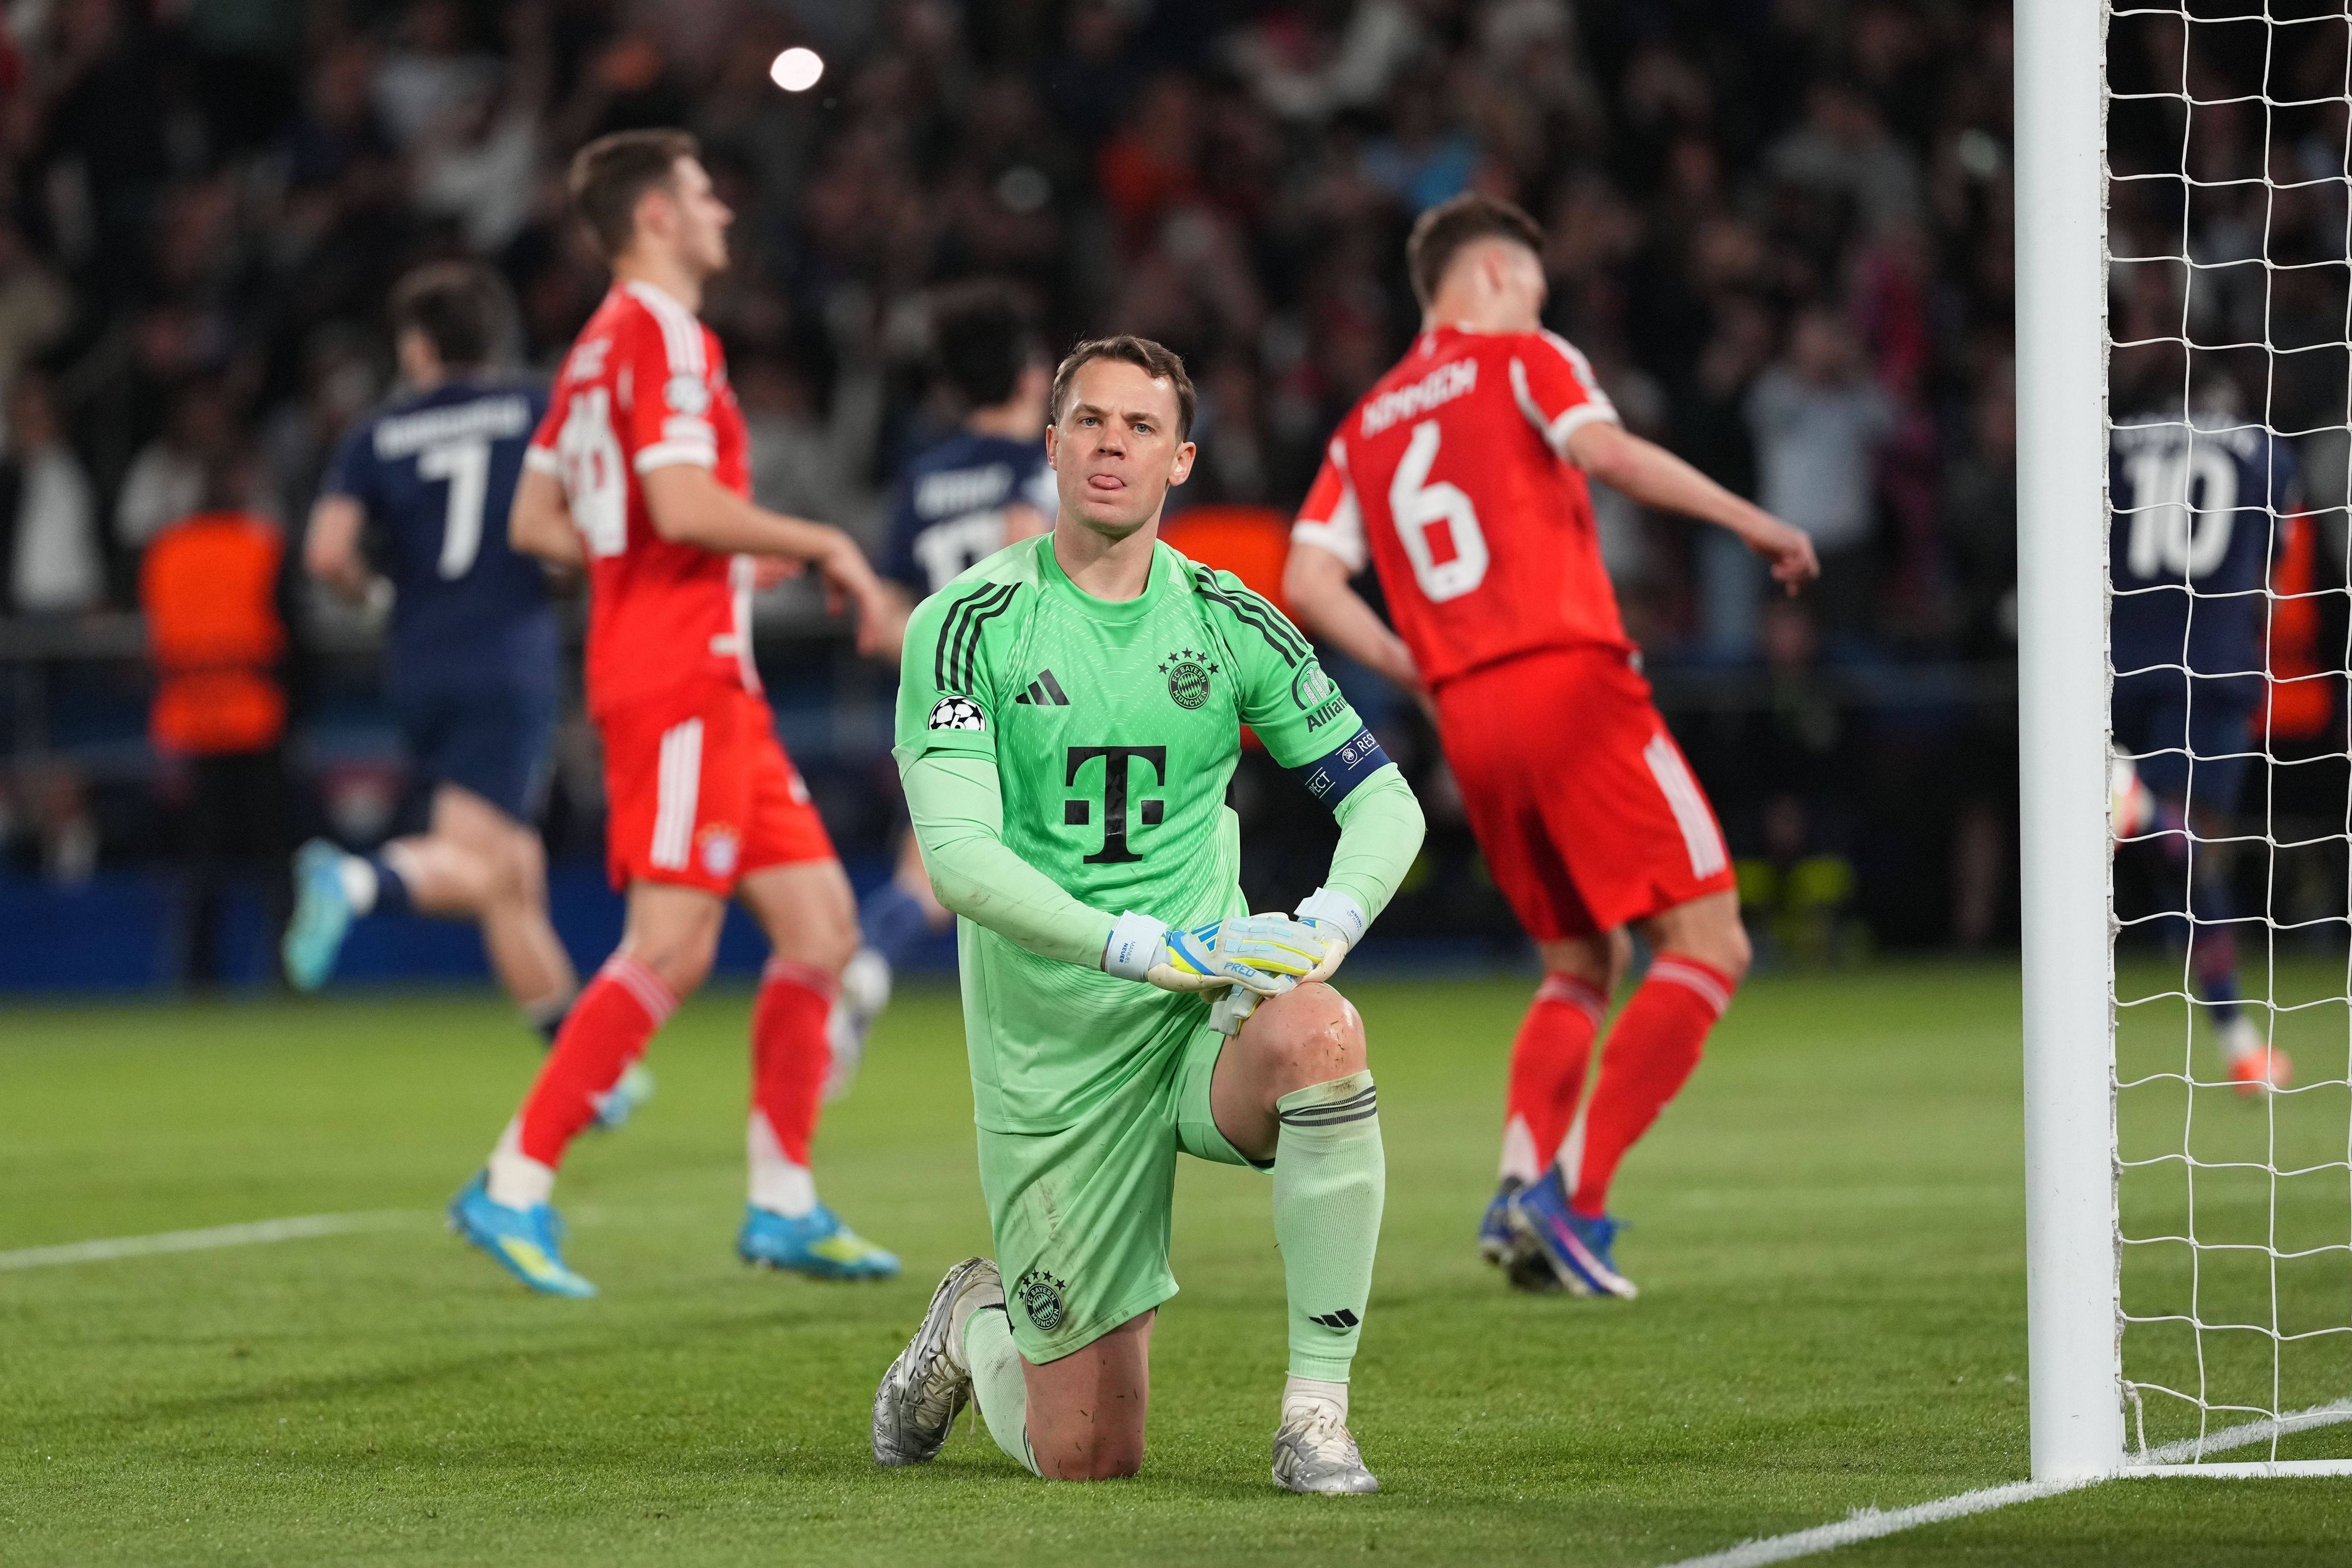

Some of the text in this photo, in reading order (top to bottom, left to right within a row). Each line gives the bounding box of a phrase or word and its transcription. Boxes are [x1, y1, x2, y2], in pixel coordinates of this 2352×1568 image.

[416, 440, 493, 581] 7
[1389, 418, 1491, 604] 6
[2122, 452, 2238, 579] 10
[1172, 666, 1207, 683] FC BAYERN
[1173, 690, 1207, 706] MÜNCHEN
[1305, 695, 1348, 733] Allian
[1119, 942, 1128, 963] NEUER
[1124, 941, 1136, 964] MANUEL
[1028, 1287, 1056, 1305] FC BAYERN
